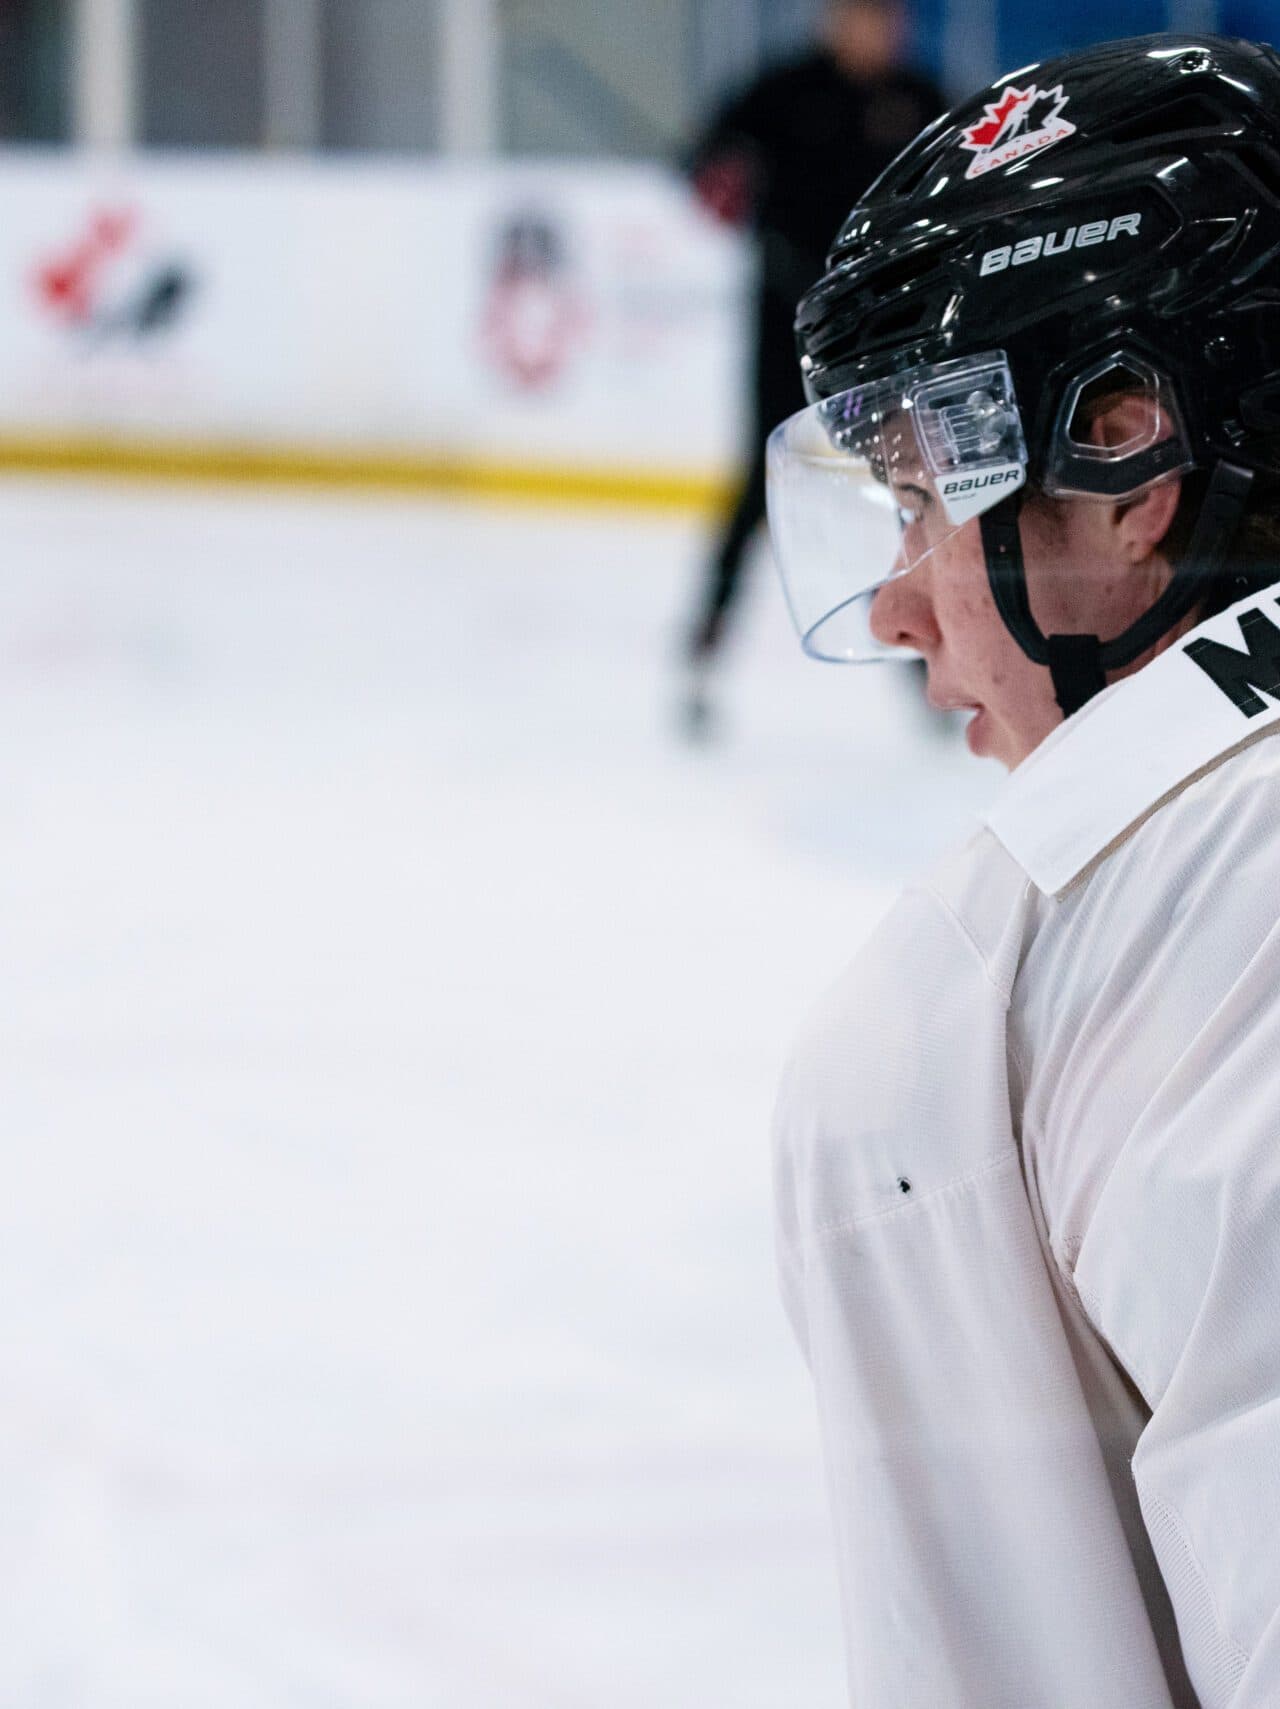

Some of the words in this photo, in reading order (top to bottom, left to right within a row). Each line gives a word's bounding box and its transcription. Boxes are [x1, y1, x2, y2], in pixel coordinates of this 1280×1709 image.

[972, 128, 1068, 174] CANADA
[979, 212, 1142, 277] BAUER
[943, 469, 1020, 495] BAUER
